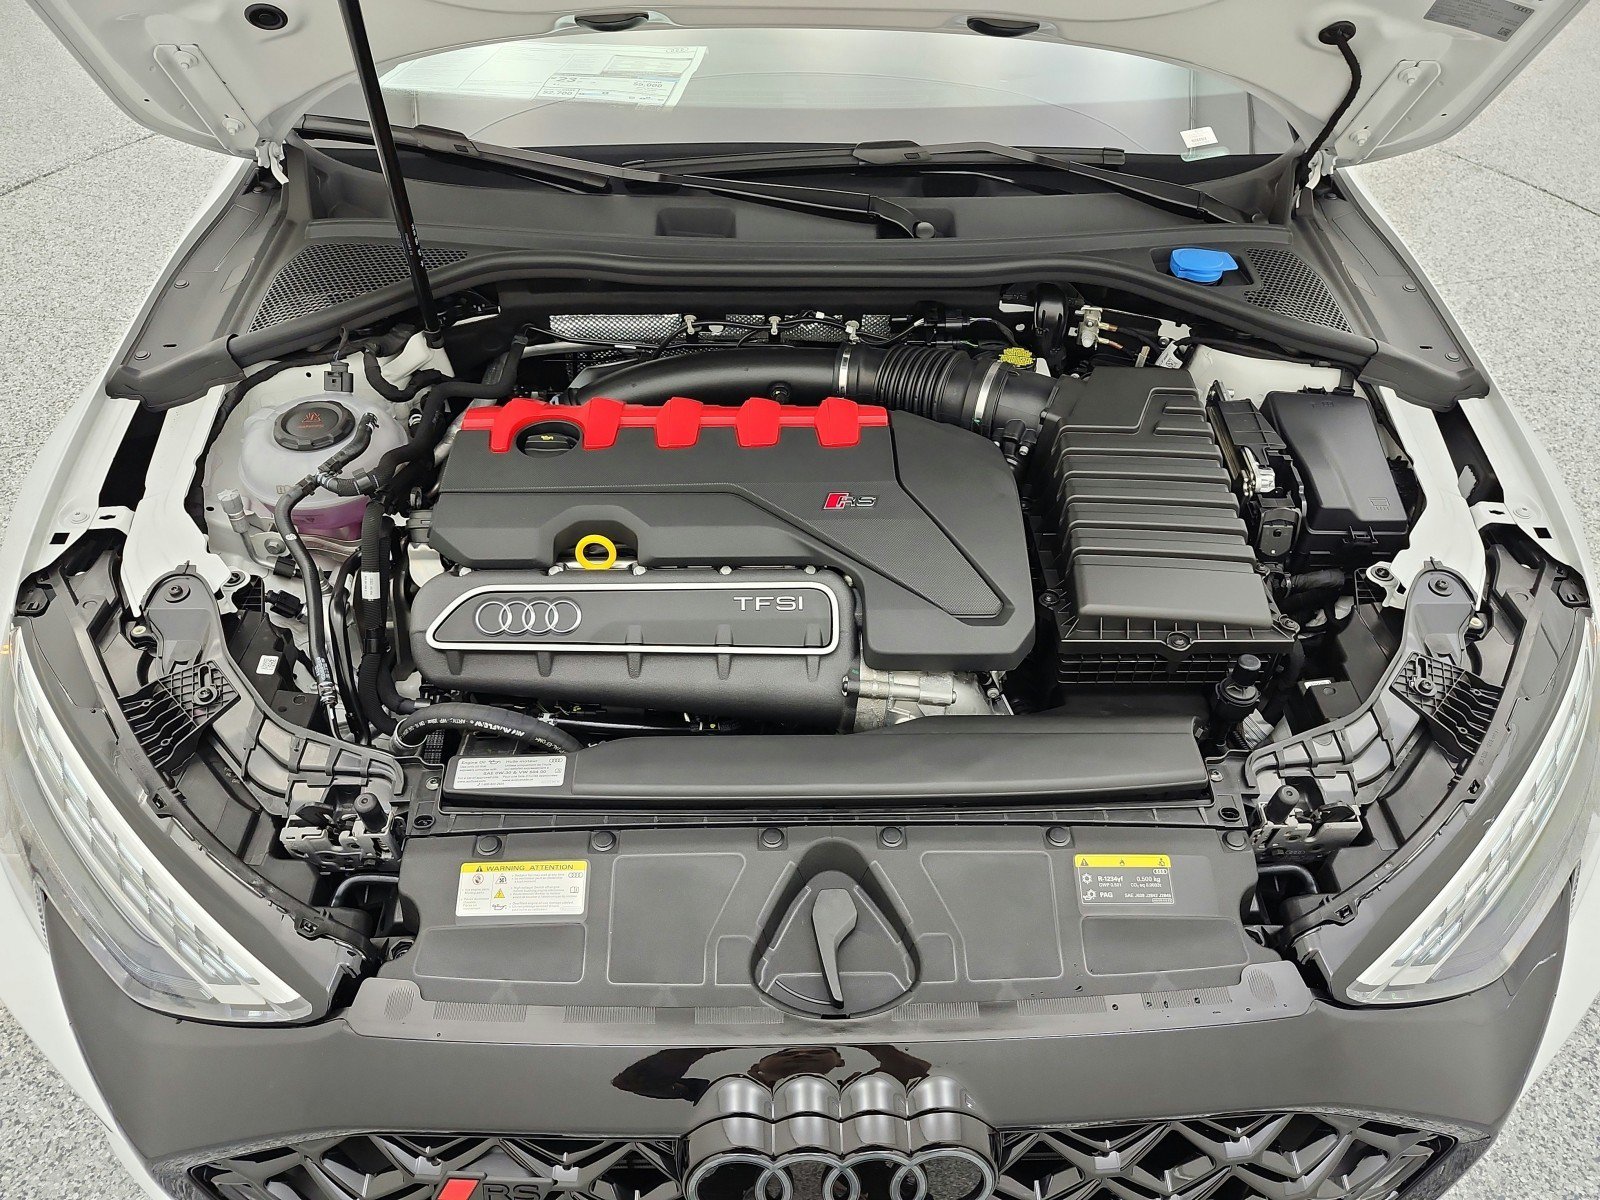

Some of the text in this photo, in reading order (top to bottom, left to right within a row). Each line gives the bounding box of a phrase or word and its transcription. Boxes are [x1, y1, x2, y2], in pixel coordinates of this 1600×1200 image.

[832, 492, 877, 509] RS
[733, 595, 804, 611] TFSI
[486, 864, 525, 872] WARNING
[482, 1183, 541, 1200] RS
